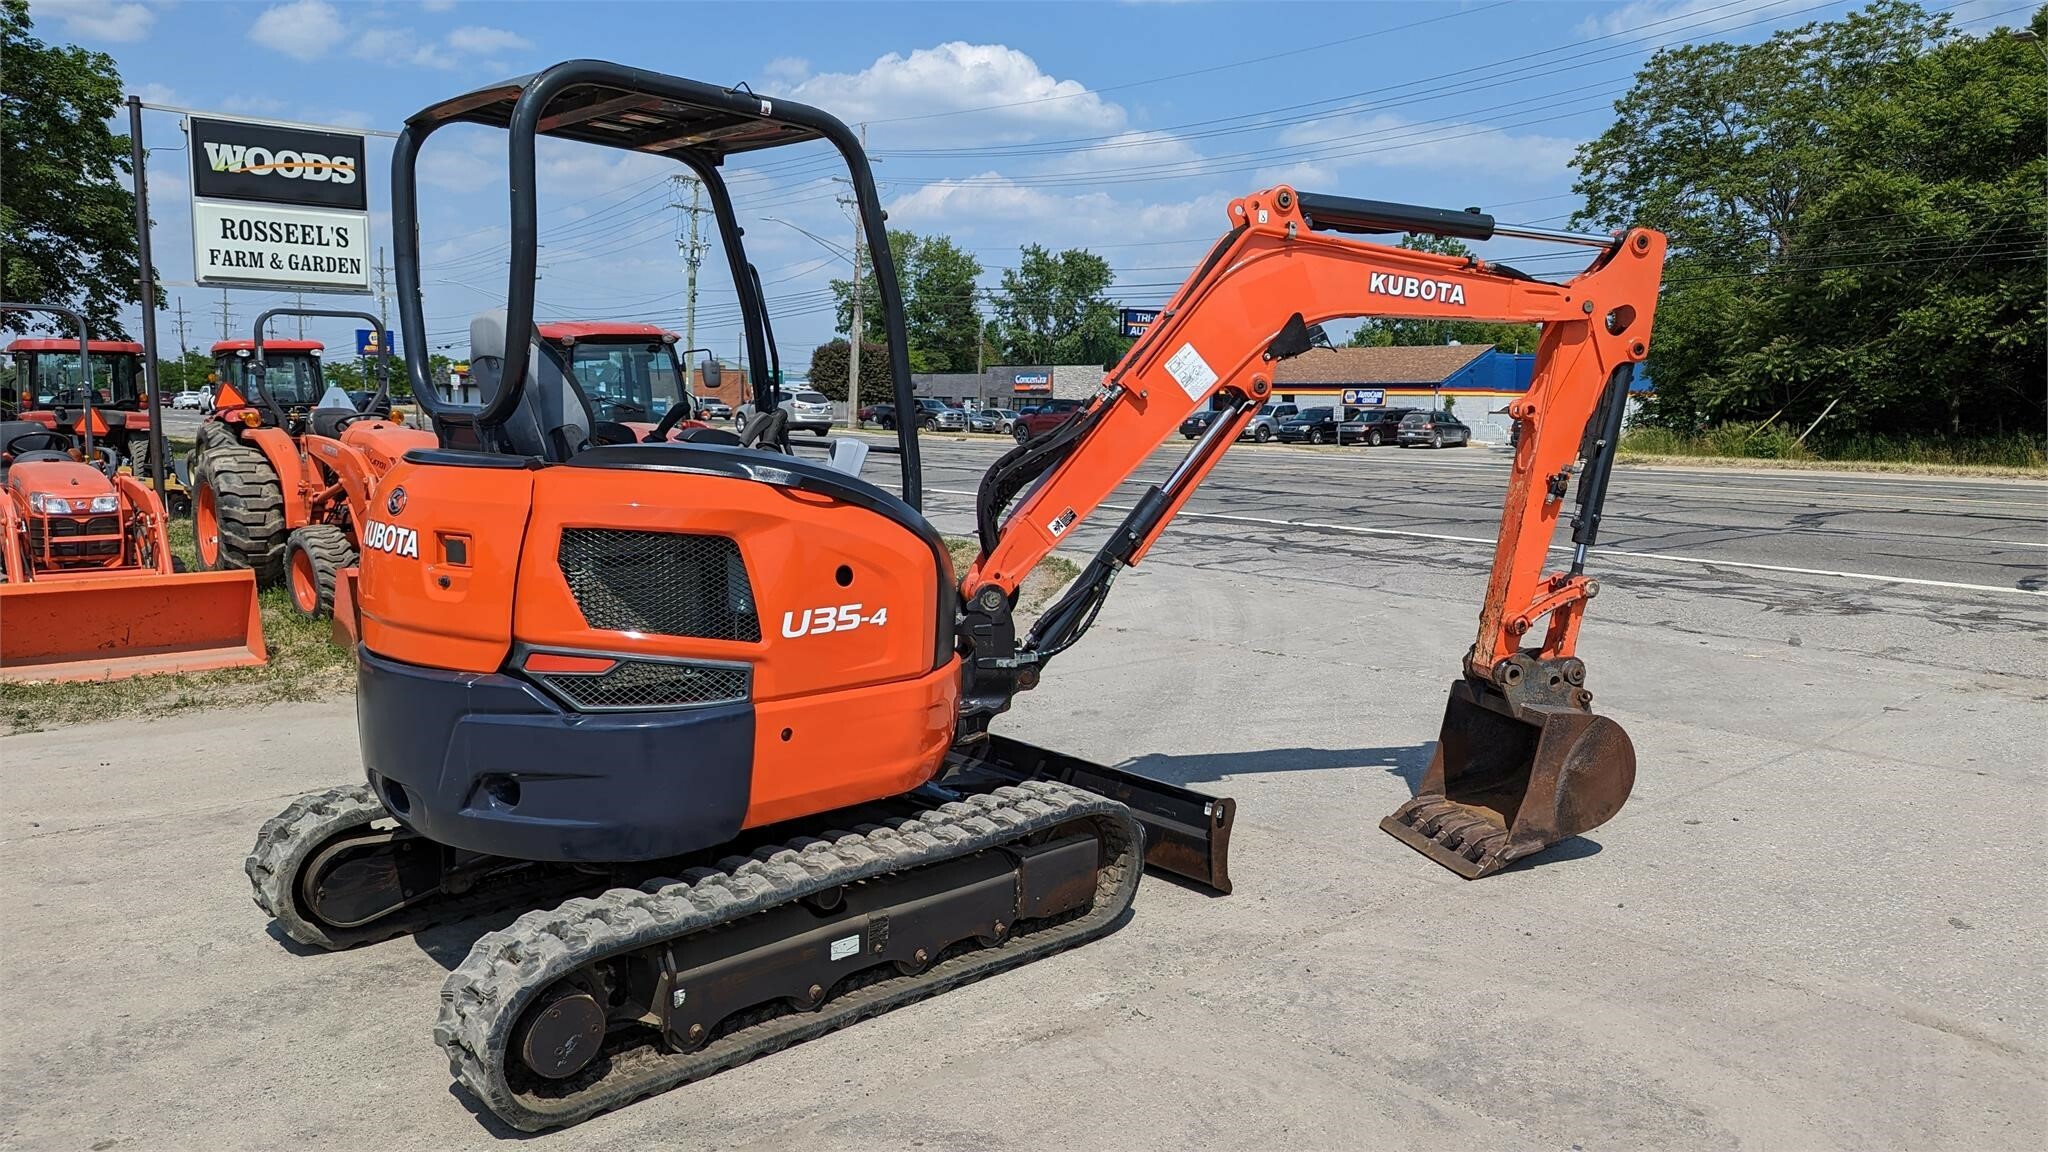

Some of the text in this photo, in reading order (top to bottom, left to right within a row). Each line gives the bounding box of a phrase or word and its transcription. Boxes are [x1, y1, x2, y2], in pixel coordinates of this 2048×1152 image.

[203, 142, 356, 184] WOODS
[220, 217, 349, 249] ROSSEEL'S
[209, 248, 361, 275] FARM & GARDEN
[1369, 272, 1465, 305] KUBOTA
[363, 519, 418, 559] KUBOTA
[781, 603, 888, 638] U35-4
